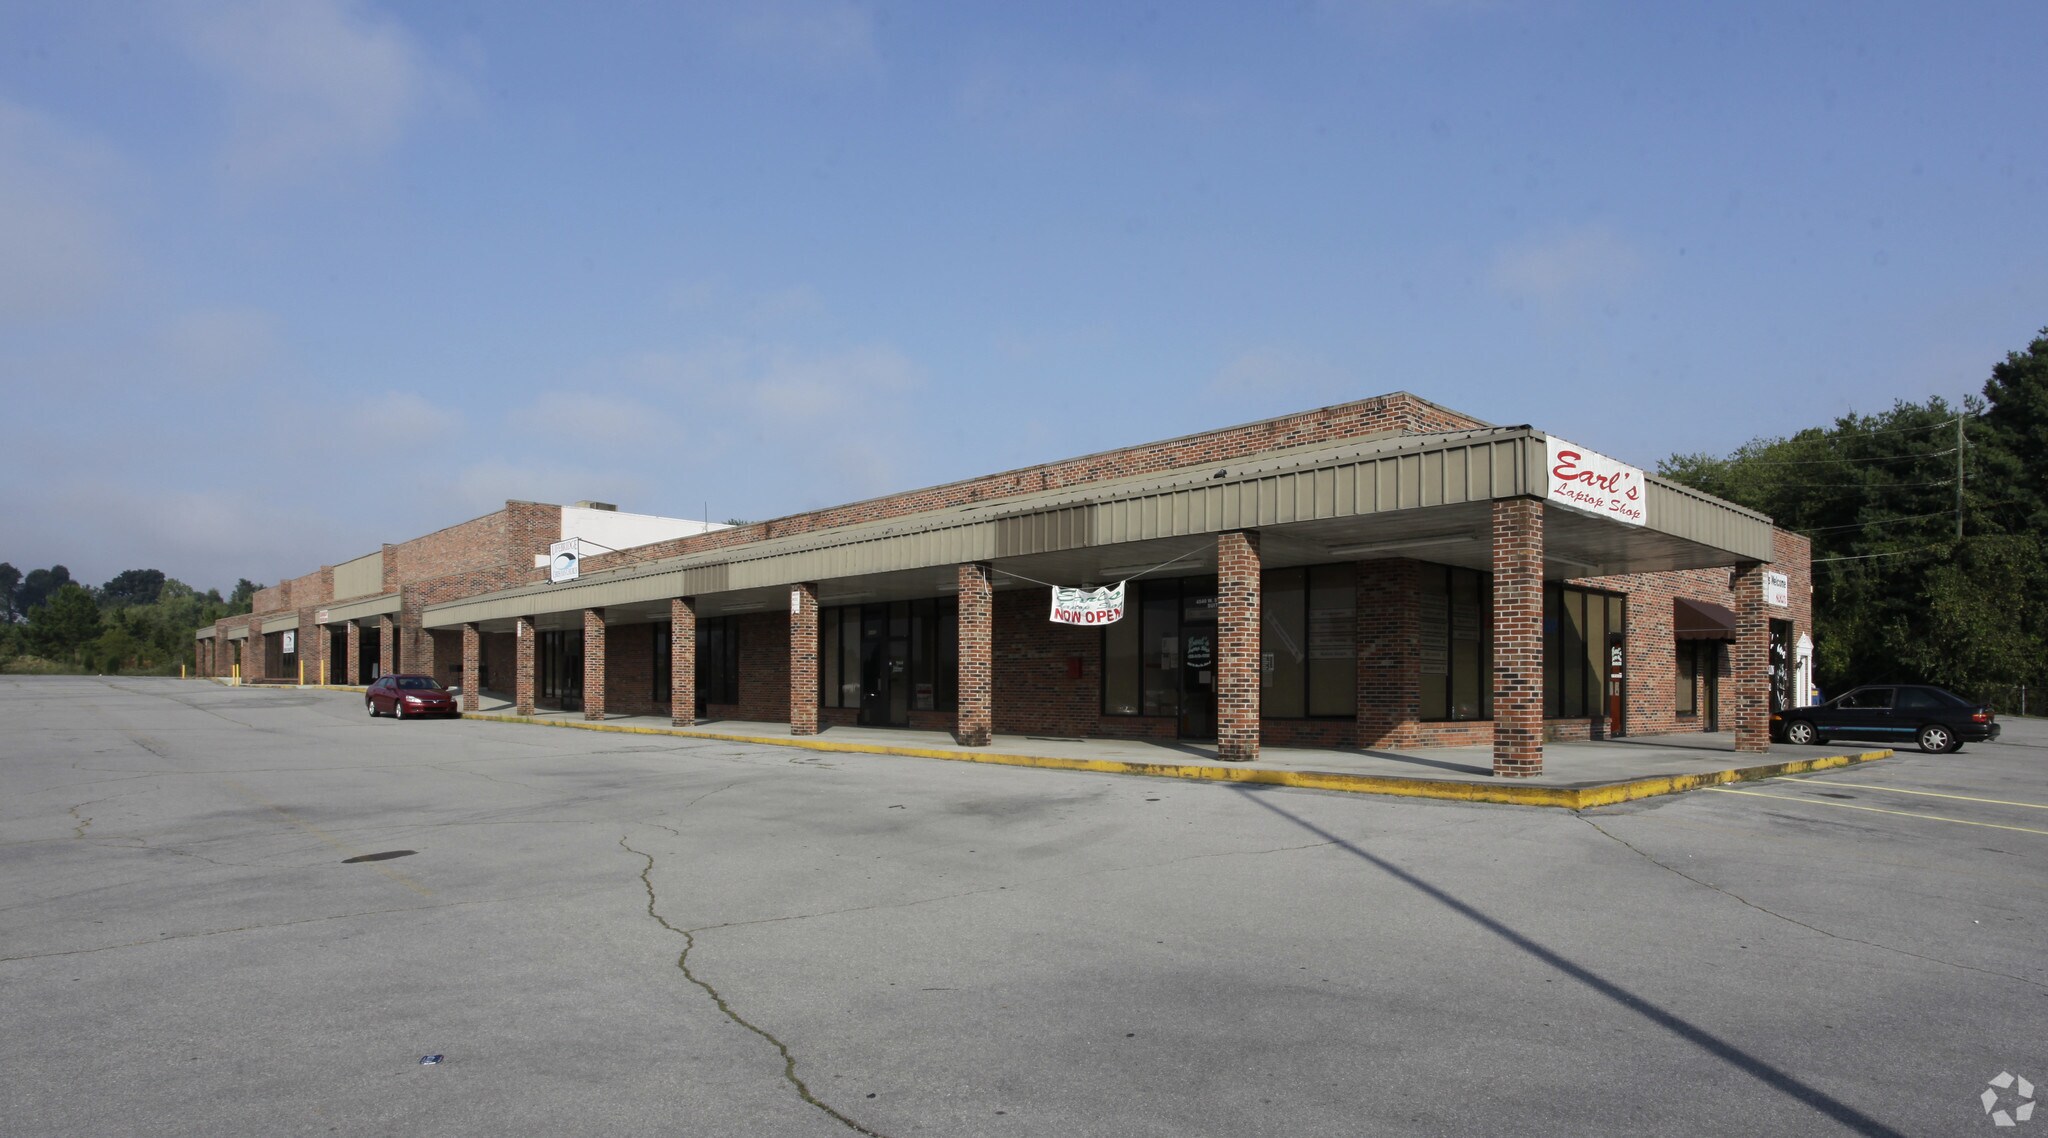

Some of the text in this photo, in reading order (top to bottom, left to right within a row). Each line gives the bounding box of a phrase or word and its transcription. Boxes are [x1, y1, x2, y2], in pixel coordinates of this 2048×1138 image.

[1552, 450, 1640, 501] Earl's
[1553, 482, 1641, 520] Laptop Shop
[1055, 607, 1122, 623] NOW OPEN
